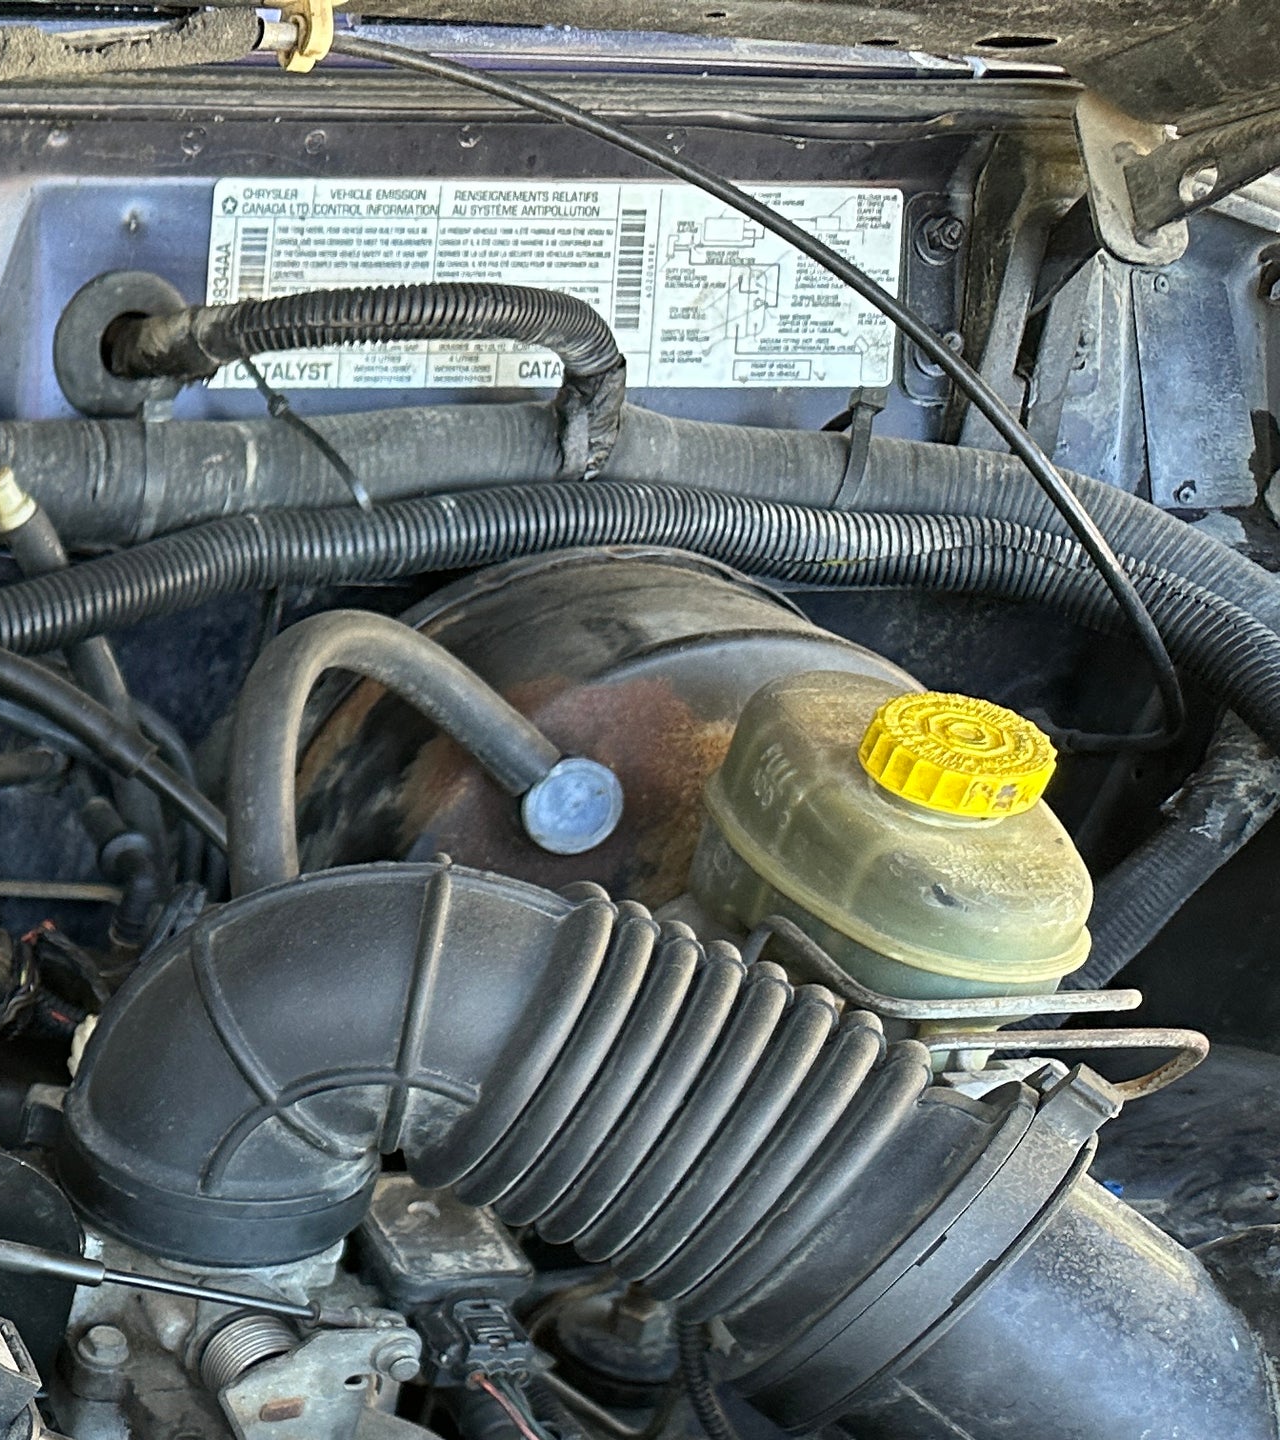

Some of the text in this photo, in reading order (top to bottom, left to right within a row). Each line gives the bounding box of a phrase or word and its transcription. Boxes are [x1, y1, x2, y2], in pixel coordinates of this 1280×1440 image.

[242, 188, 298, 200] CHRYSLER
[330, 188, 427, 201] VEHICLE EMISSION
[454, 190, 599, 203] RENSEIGNEMENTS RELATIFS
[241, 202, 287, 215] CANADA
[313, 203, 438, 216] CONTROL INFORMATION
[452, 204, 467, 216] AU
[521, 205, 601, 217] ANTIPOLLUTION
